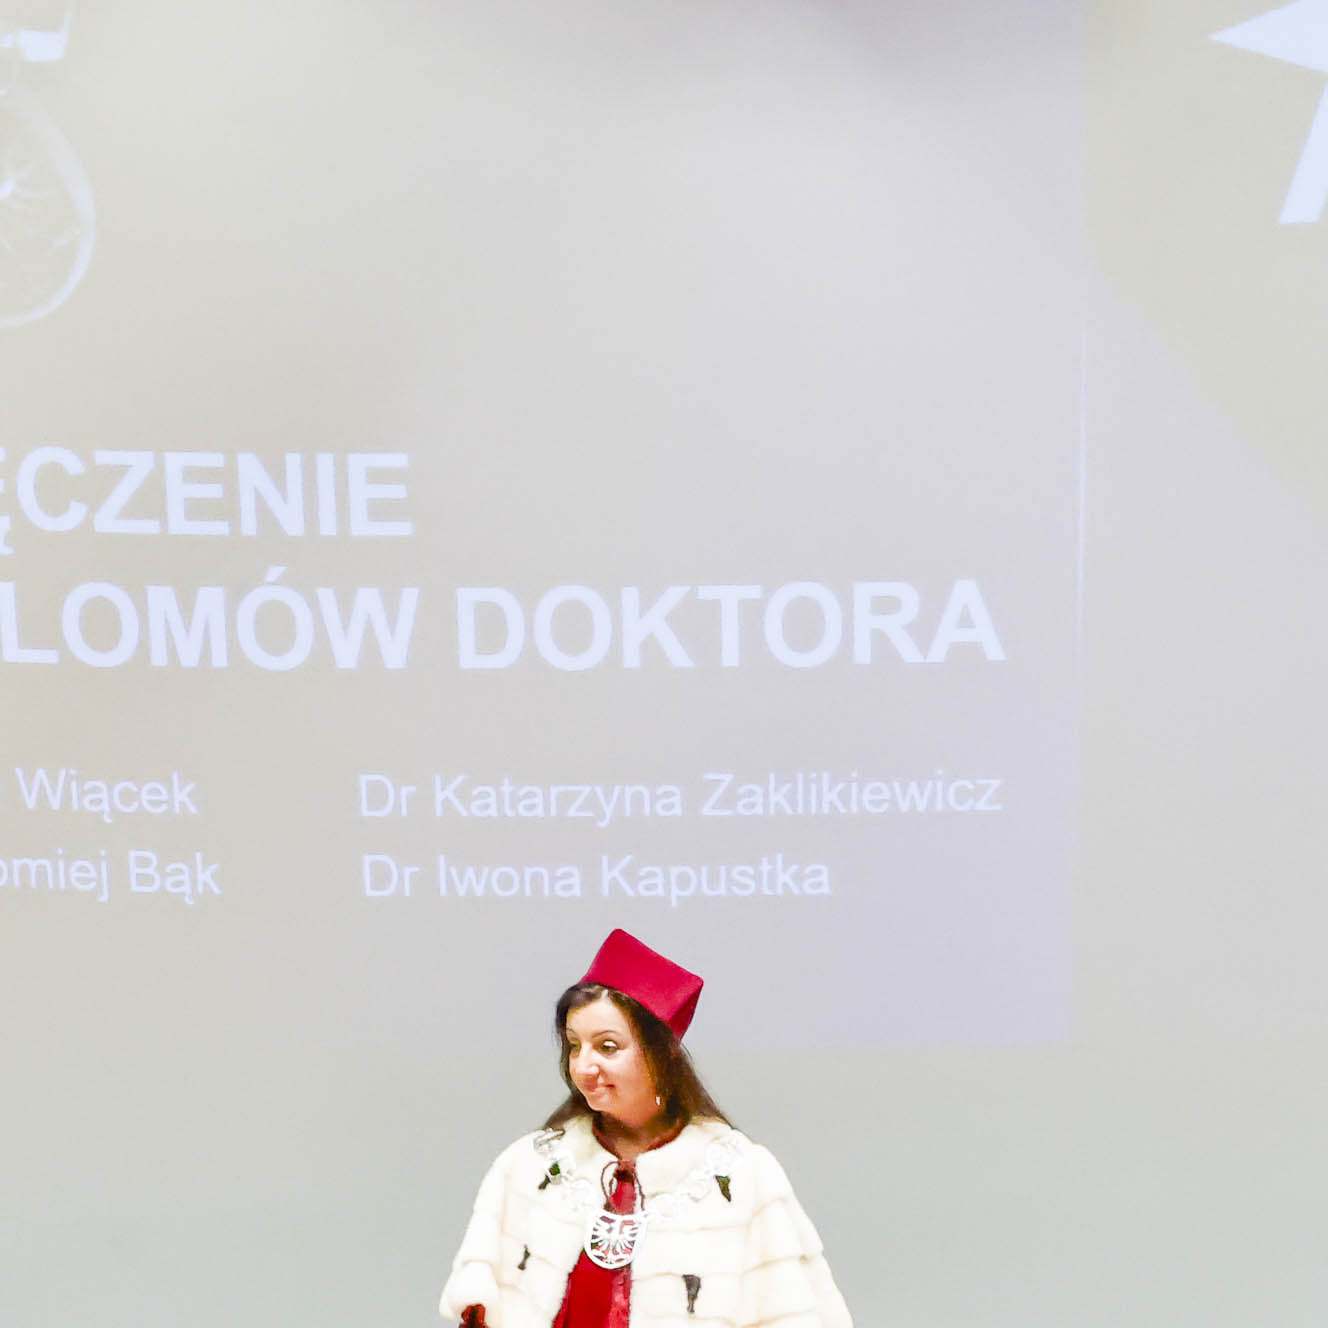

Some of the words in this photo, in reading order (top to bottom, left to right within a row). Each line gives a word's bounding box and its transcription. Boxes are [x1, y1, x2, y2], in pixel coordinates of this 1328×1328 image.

[456, 579, 1008, 672] DOKTORA
[15, 768, 200, 825] Wiącek
[358, 774, 418, 820] Dr
[435, 774, 684, 830] Katarzyna
[701, 772, 1003, 819] Zaklikiewicz
[129, 850, 223, 906] Bąk
[363, 854, 422, 899] Dr
[438, 855, 583, 899] Iwona
[601, 854, 832, 911] Kapustka
